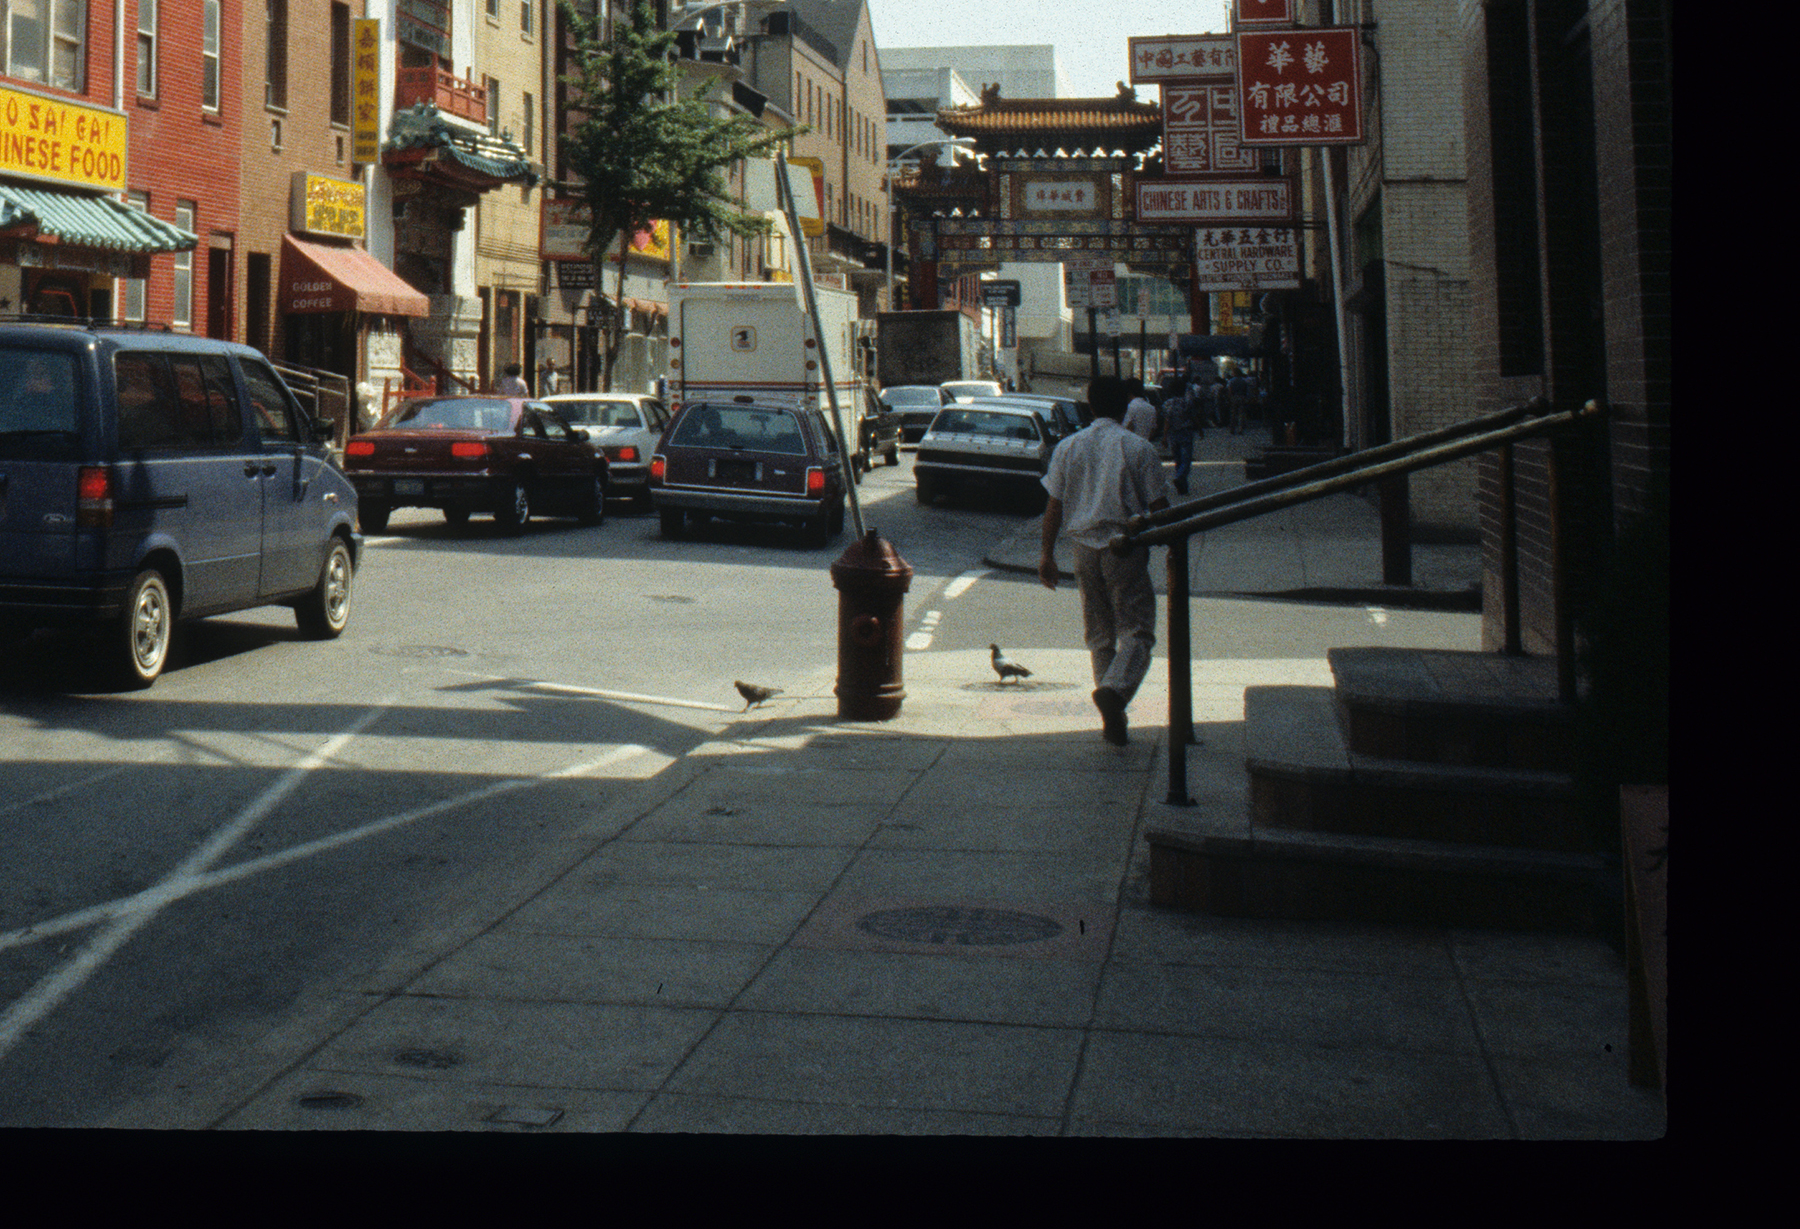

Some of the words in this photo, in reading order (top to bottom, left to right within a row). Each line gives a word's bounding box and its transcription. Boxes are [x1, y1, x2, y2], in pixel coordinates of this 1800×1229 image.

[1248, 79, 1349, 110] 有限公司
[28, 102, 66, 135] SAI
[75, 113, 111, 146] GAI
[69, 143, 122, 183] FOOD
[1143, 190, 1187, 212] CHINESE
[1192, 190, 1220, 212] ARTS
[1237, 189, 1277, 211] CRAFTS
[1198, 248, 1237, 261] CENTRAL
[1241, 245, 1294, 258] HARDWARE
[1212, 260, 1256, 273] SUPPLY
[1265, 258, 1283, 271] CO.
[292, 282, 332, 292] GOLDEN
[292, 298, 332, 309] COFFEE
